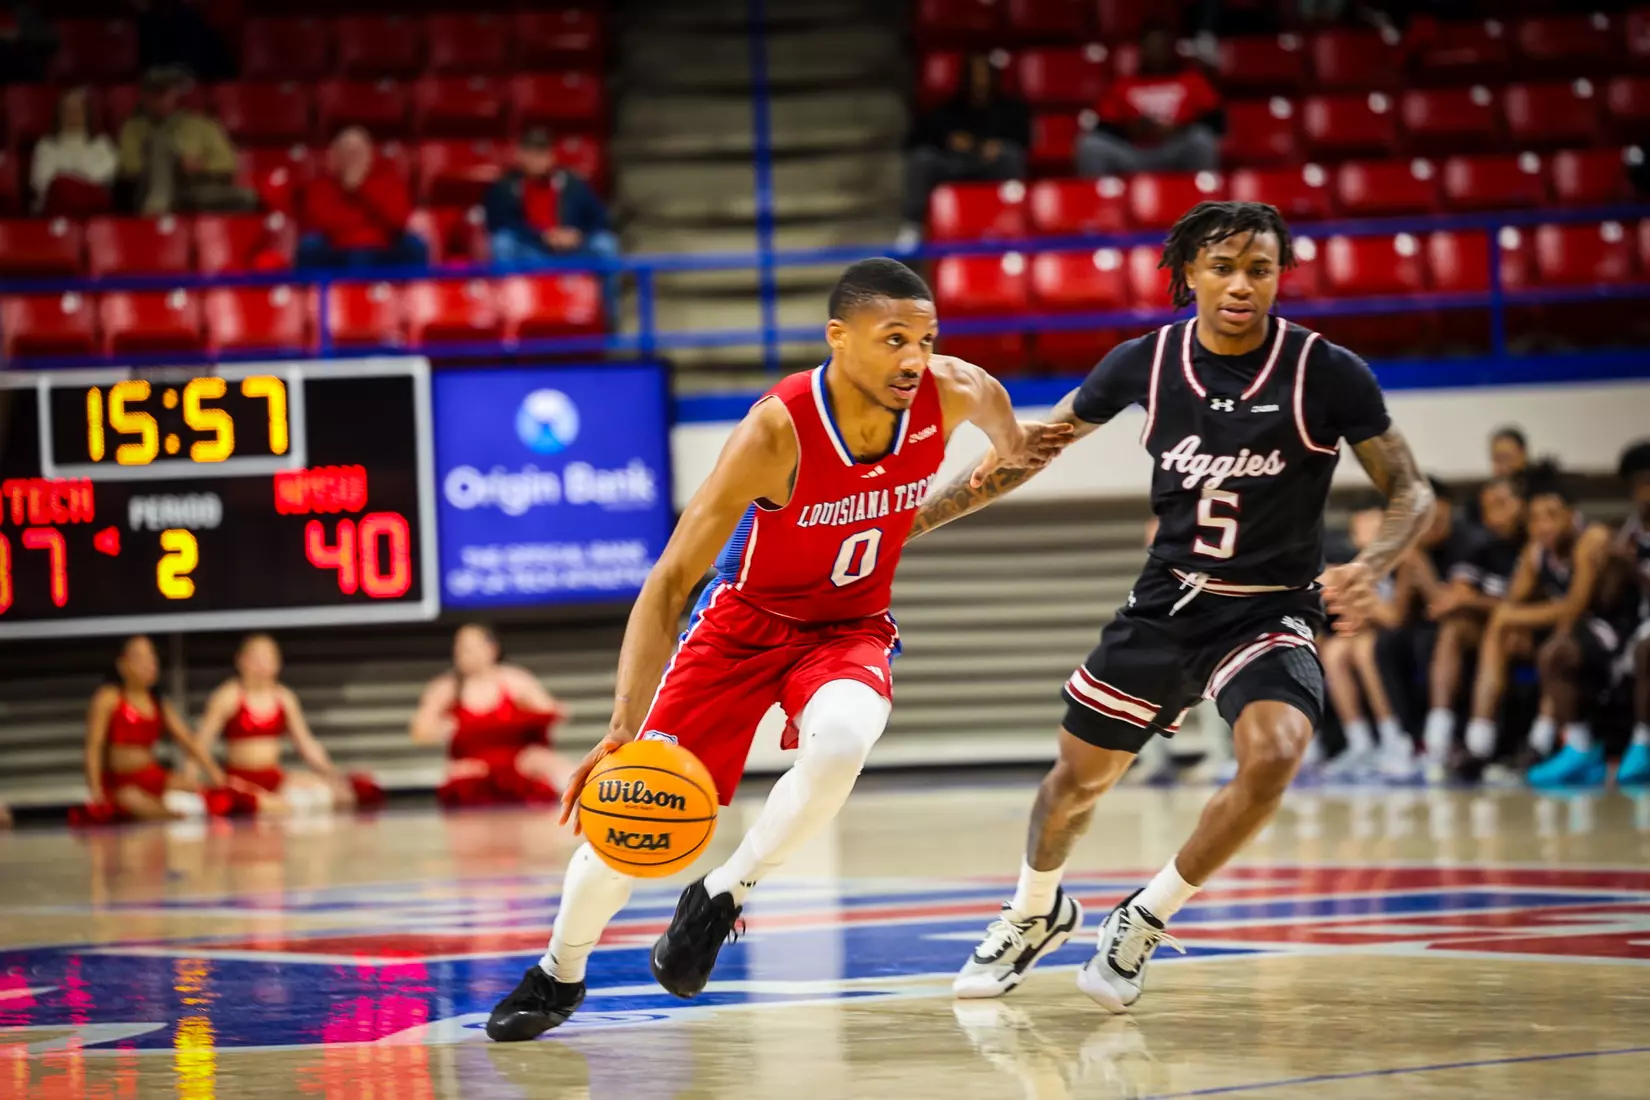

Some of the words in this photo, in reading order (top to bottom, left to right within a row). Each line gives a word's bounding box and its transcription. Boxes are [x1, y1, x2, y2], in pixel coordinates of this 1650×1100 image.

[87, 375, 288, 465] 15:57
[444, 463, 561, 516] Origin
[1160, 434, 1287, 489] Aggies
[0, 475, 95, 526] TECH
[797, 489, 890, 528] LOUISIANA
[1192, 488, 1240, 561] 5
[0, 526, 69, 615] 7
[156, 528, 198, 599] 2
[305, 512, 411, 598] 40
[830, 527, 884, 588] 0
[598, 780, 686, 811] Wilson
[606, 828, 671, 850] NCAA
